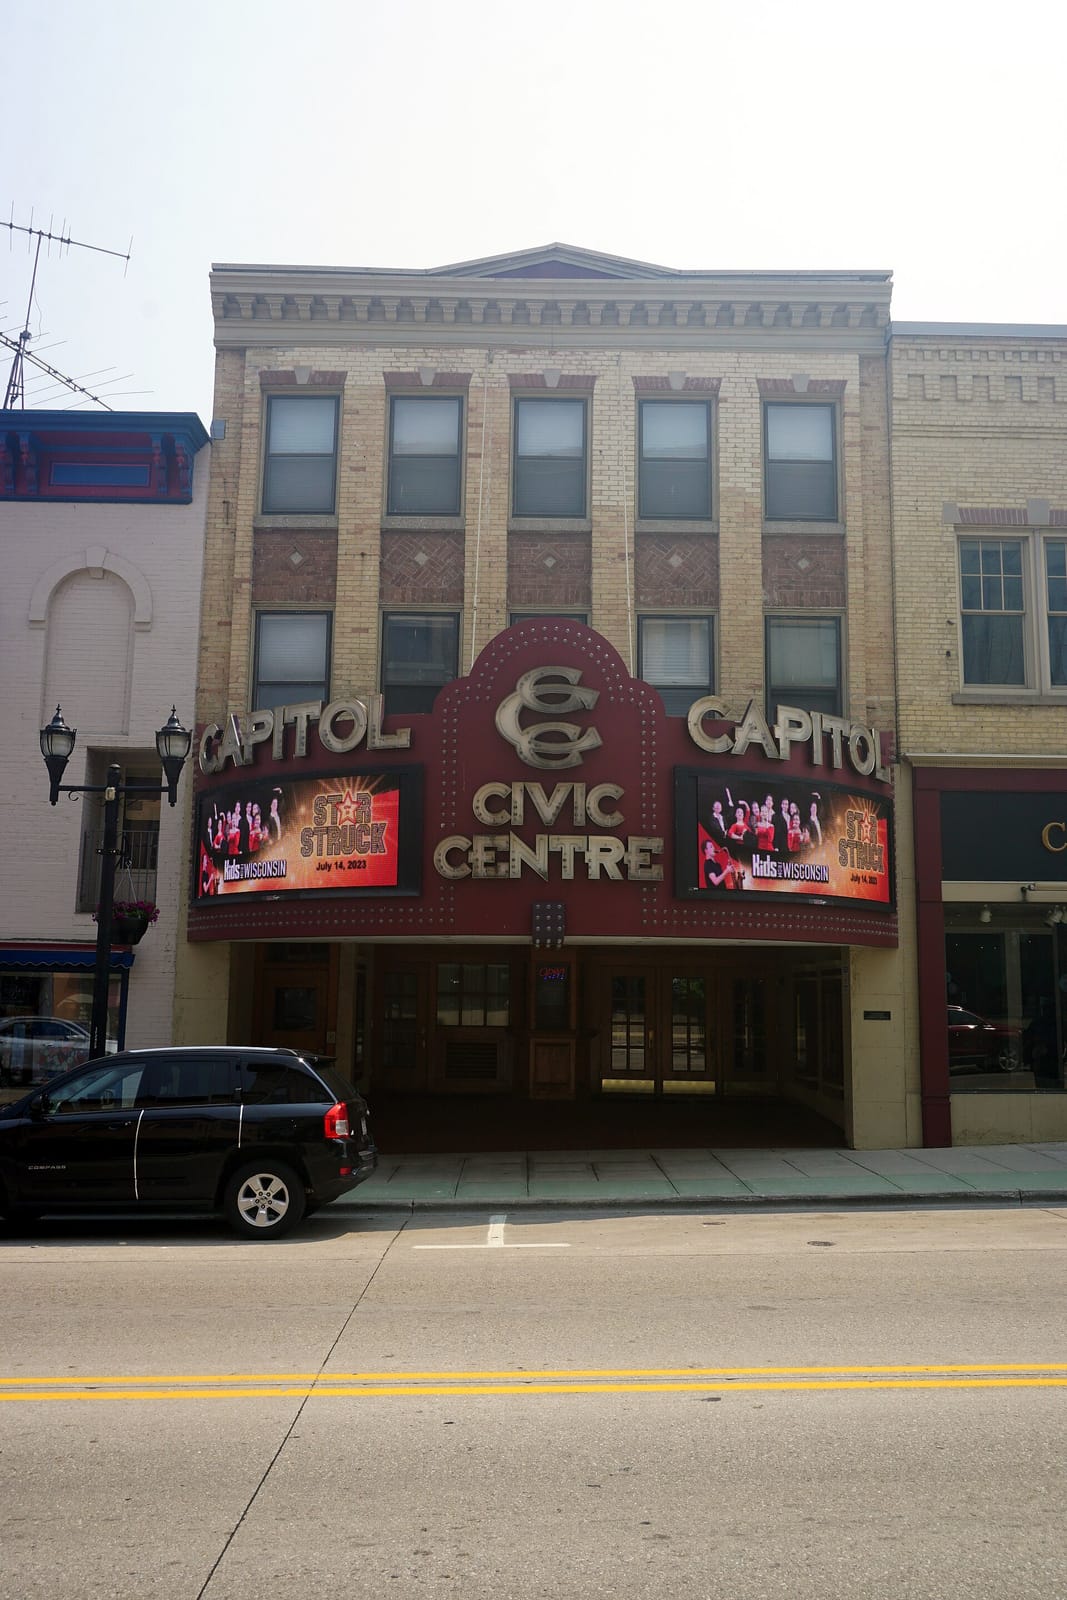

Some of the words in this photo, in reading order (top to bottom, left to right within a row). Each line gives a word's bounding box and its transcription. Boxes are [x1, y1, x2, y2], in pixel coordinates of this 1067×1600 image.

[198, 693, 412, 775] CAPITOL
[687, 695, 892, 784] CAPITOL
[472, 781, 625, 828] CIVIC
[300, 822, 388, 858] STRUCK
[433, 831, 664, 882] CENTRE
[838, 838, 885, 874] STRUCK
[224, 858, 240, 881] Kids
[244, 859, 287, 879] WISCONSIN
[316, 861, 332, 872] July
[334, 861, 346, 871] 14,
[347, 859, 367, 870] 2023
[751, 853, 777, 878] Kids
[783, 862, 829, 882] WISCONSIN
[850, 873, 861, 885] July
